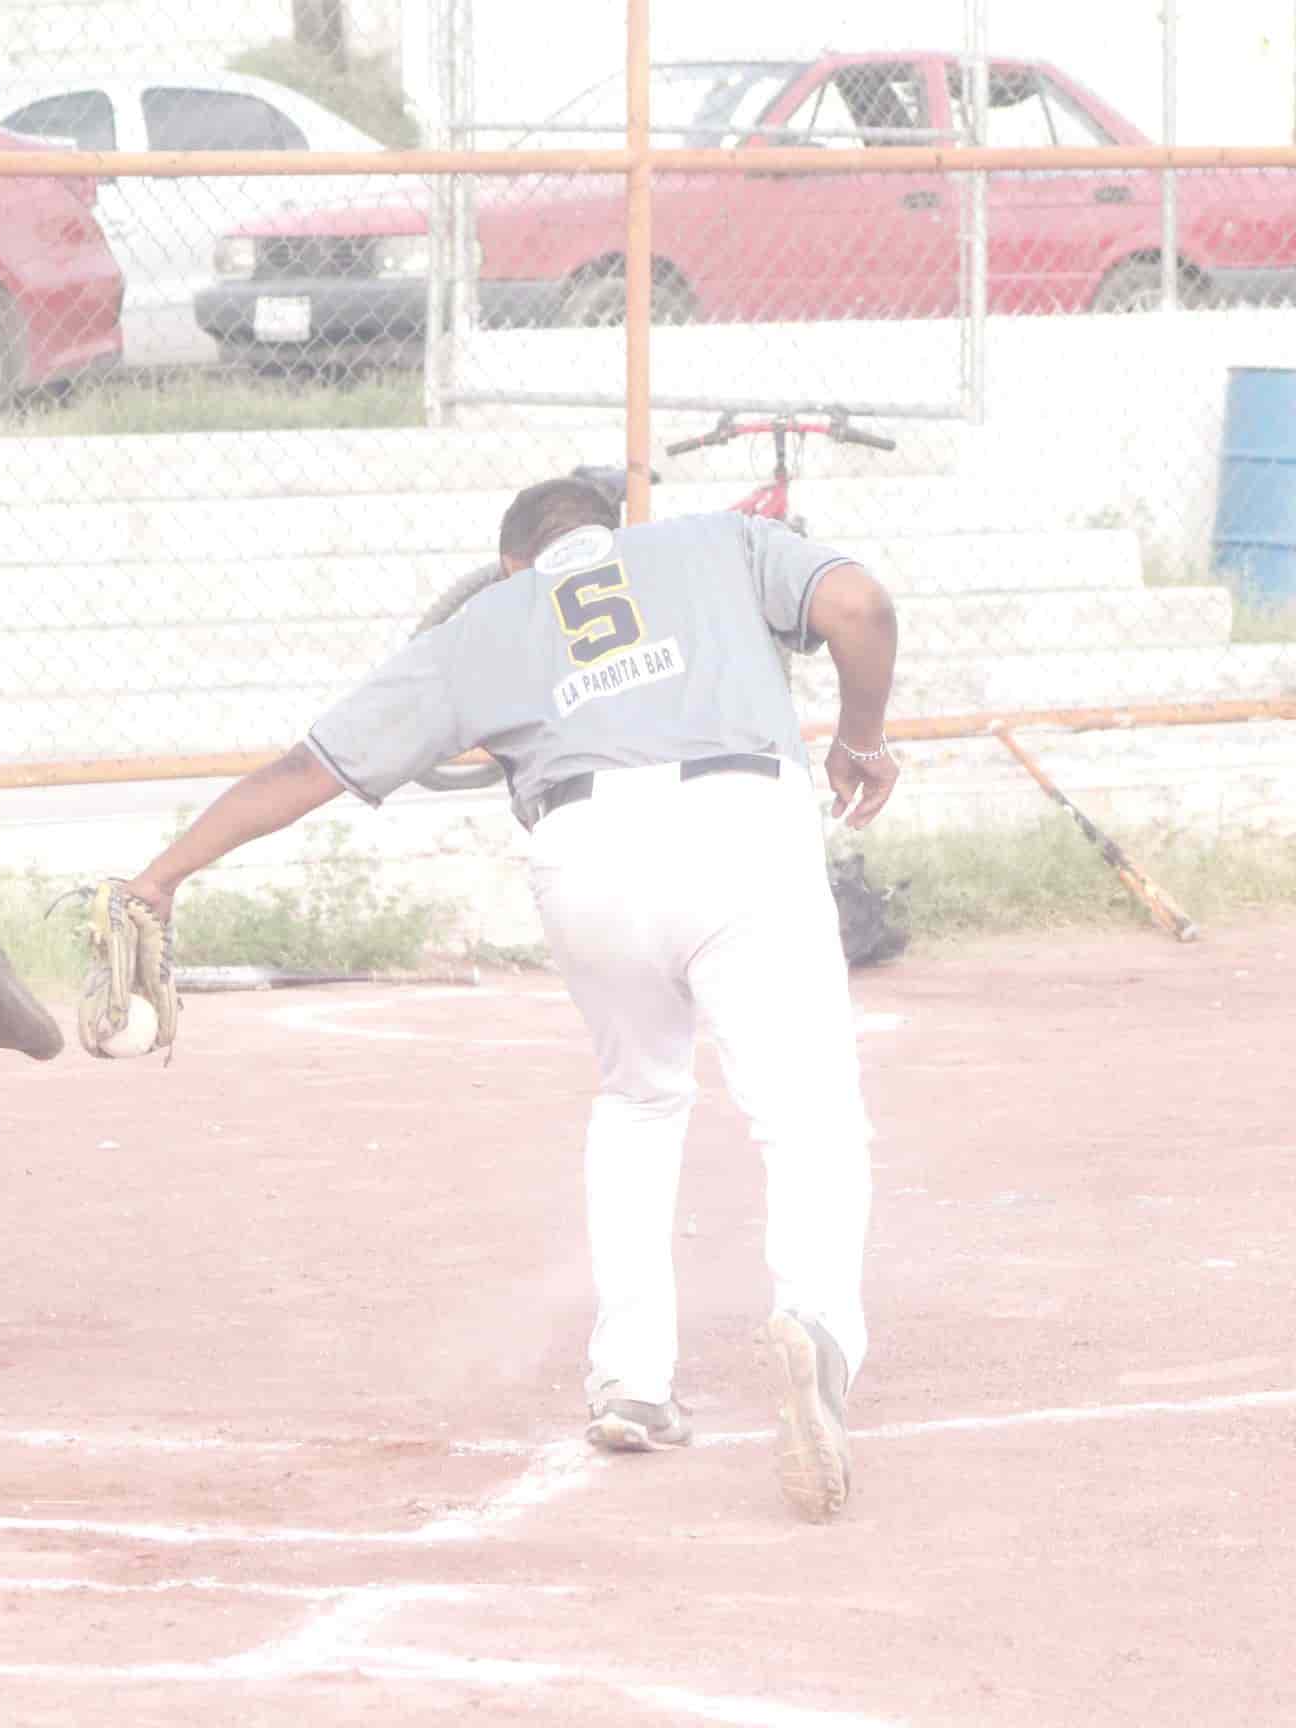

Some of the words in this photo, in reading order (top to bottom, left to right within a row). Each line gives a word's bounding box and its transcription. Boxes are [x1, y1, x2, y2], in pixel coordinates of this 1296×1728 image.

[550, 560, 644, 667] 5
[561, 682, 581, 706] LA
[582, 656, 641, 693] PARRITA
[644, 648, 674, 674] BAR
